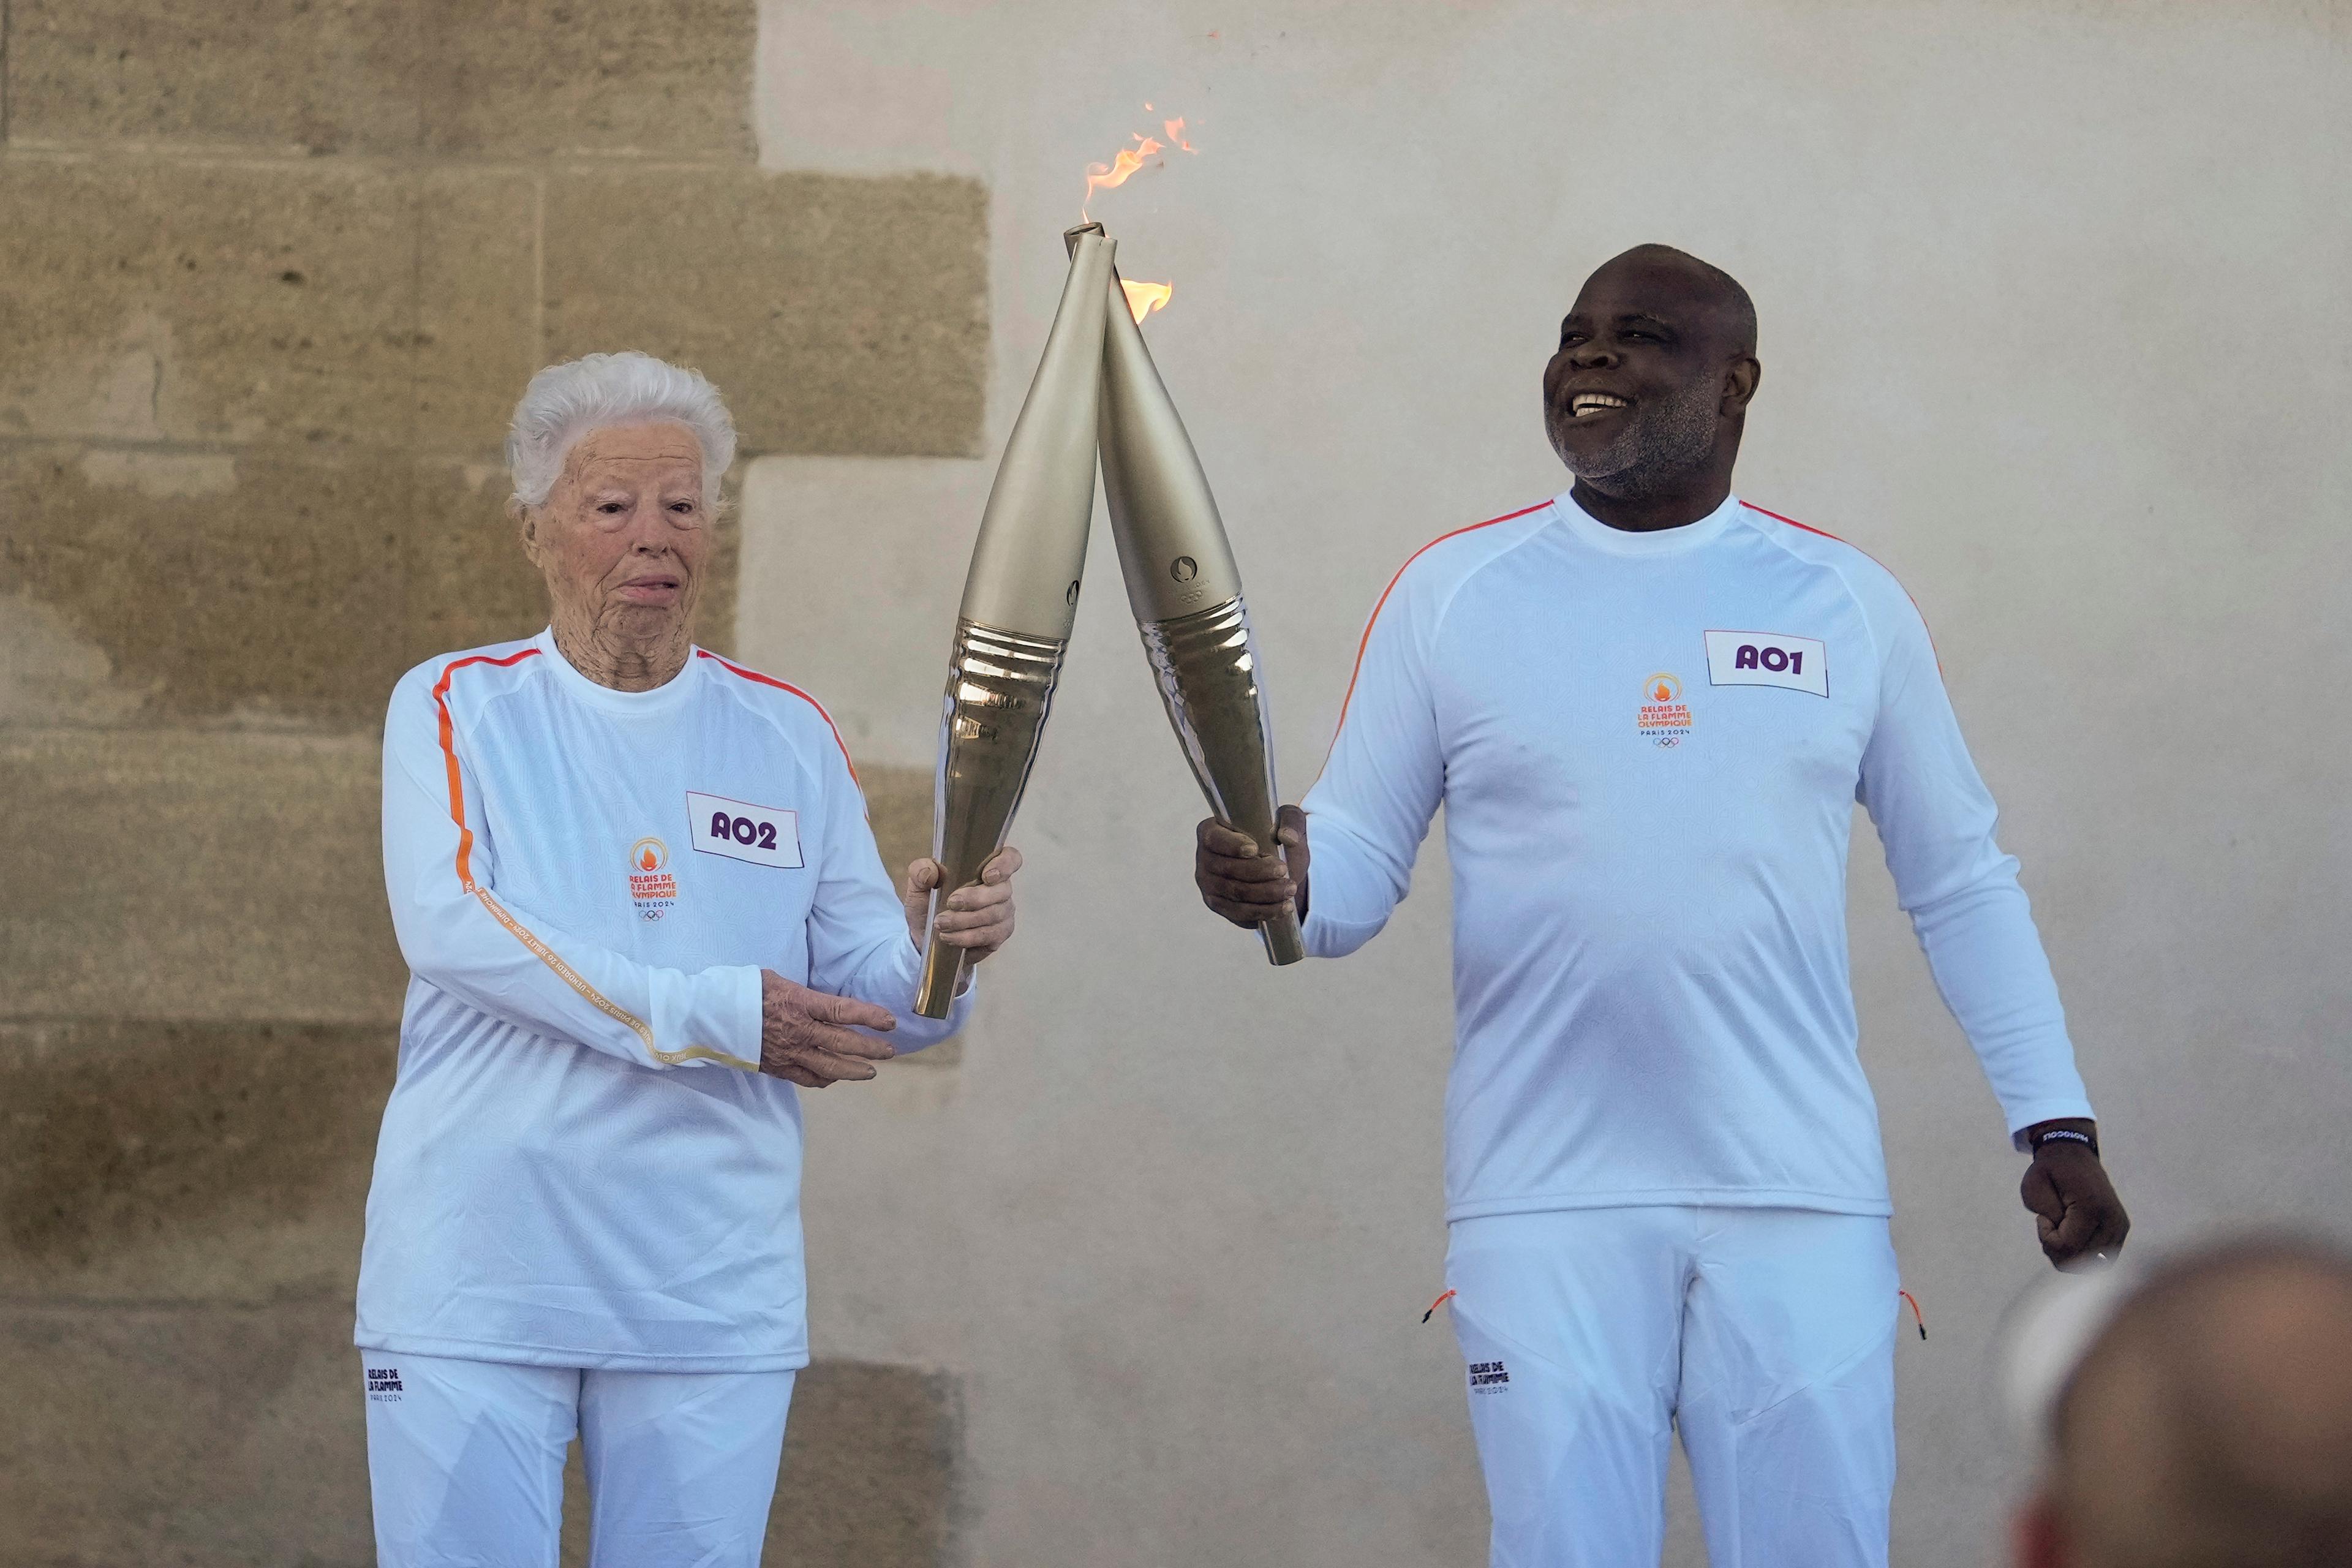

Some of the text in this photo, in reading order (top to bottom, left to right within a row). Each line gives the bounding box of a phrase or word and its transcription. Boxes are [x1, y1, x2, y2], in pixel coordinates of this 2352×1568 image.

[1638, 719, 1692, 728] OLYMPIQUE
[661, 873, 672, 882] DE
[637, 882, 677, 891] FLAMME
[480, 892, 510, 924] DIMANCHE
[513, 925, 530, 940] 2024
[527, 938, 549, 956] JUILLET
[548, 954, 557, 965] 26
[556, 962, 586, 991] VENDREDI
[590, 993, 611, 1010] 2024
[609, 1008, 631, 1022] PARIS
[630, 1019, 641, 1029] DE
[1491, 1361, 1504, 1371] DE
[368, 1369, 398, 1379] RELAIS DE
[369, 1381, 402, 1391] LA FLAMME
